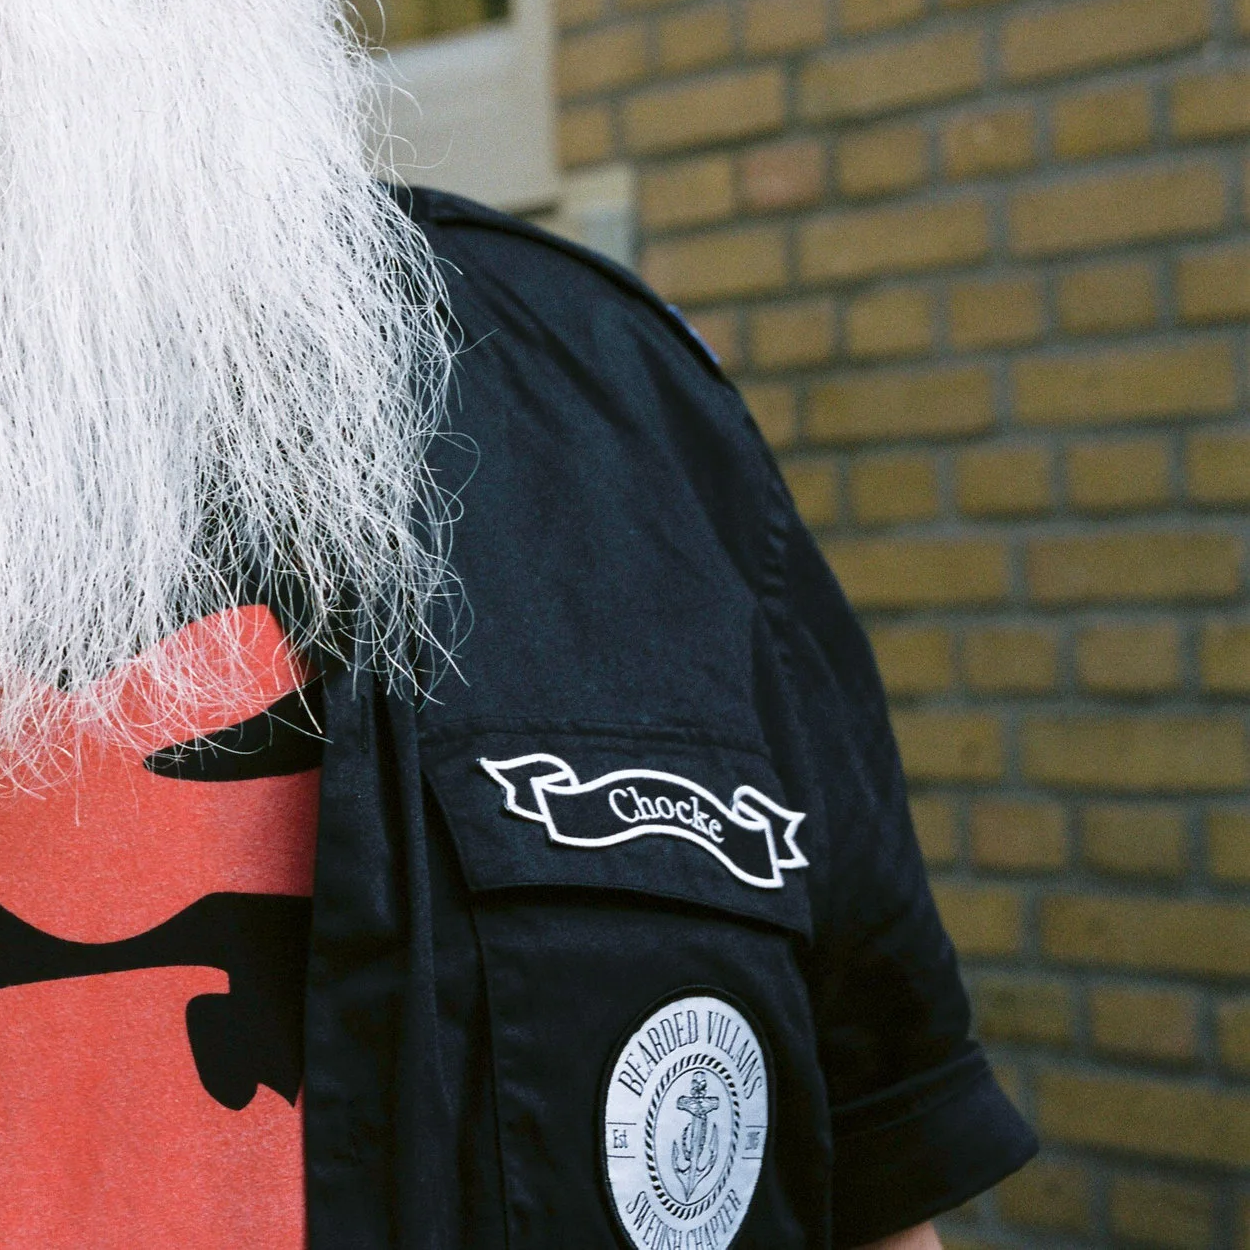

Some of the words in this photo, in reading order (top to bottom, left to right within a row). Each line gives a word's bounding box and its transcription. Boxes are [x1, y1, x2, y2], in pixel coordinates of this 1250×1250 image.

[608, 786, 726, 843] Chocke
[617, 1009, 699, 1098] BEARDED
[706, 1010, 763, 1100] VILLAINS
[612, 1129, 629, 1149] Est
[685, 1188, 743, 1250] CHAPTER
